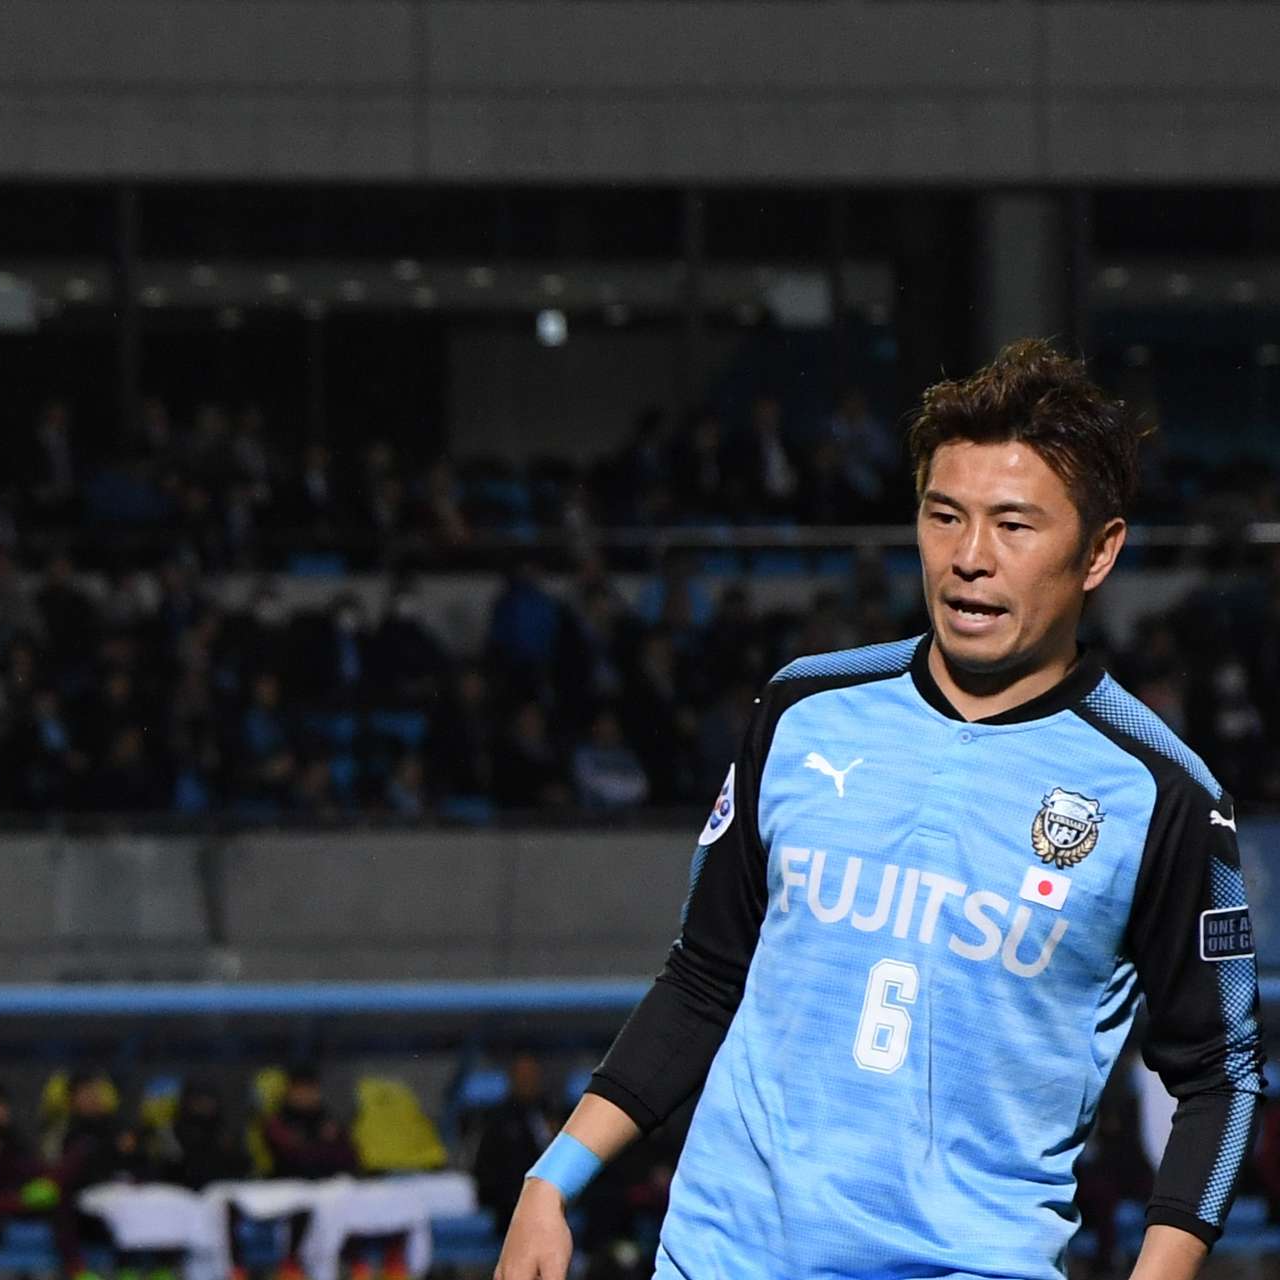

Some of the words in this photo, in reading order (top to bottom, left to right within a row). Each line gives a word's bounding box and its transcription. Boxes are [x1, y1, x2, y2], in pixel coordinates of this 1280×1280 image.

[777, 847, 1069, 978] FUJITSU
[1208, 919, 1235, 936] ONE
[1208, 935, 1235, 952] ONE
[852, 957, 919, 1074] 6
